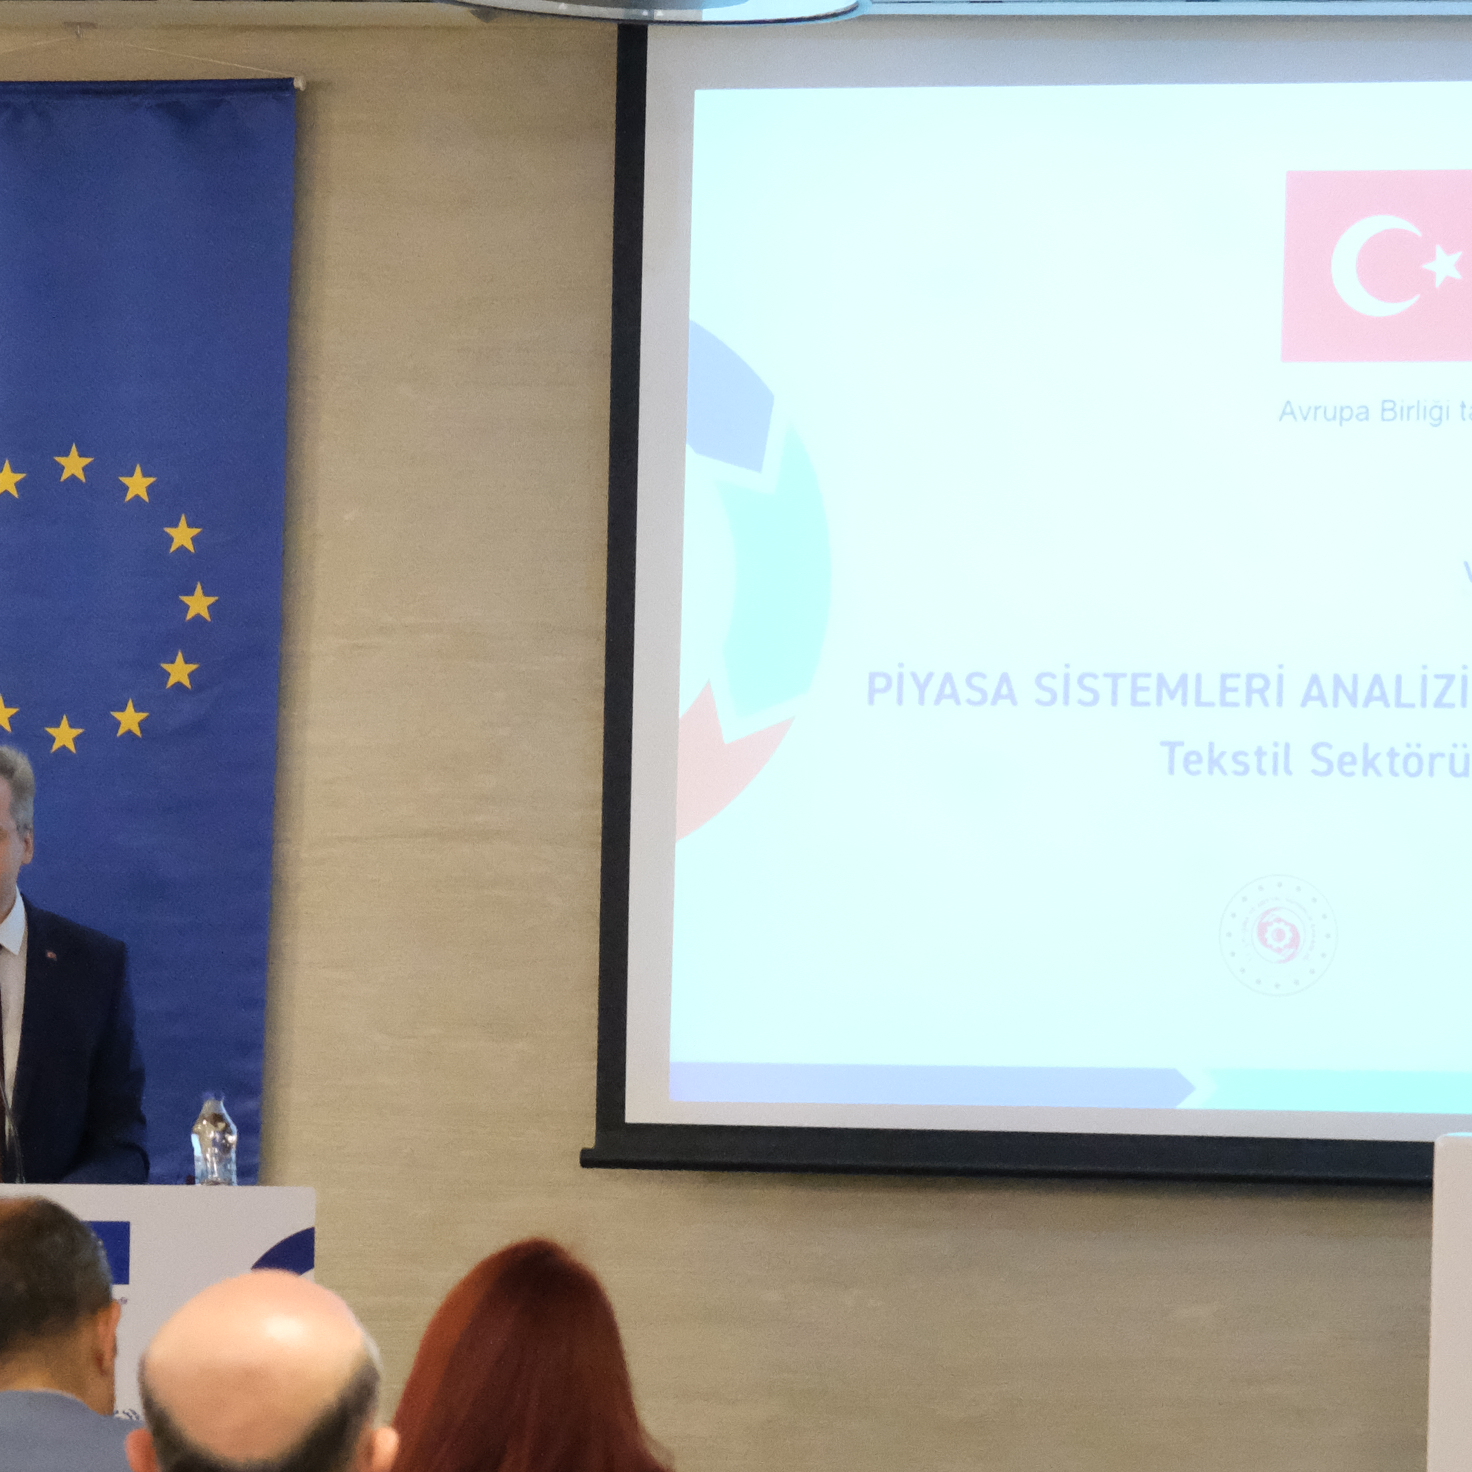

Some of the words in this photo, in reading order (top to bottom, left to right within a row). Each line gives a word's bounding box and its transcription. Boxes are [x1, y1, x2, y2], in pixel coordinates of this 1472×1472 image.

[1278, 399, 1370, 427] Avrupa
[1380, 398, 1450, 428] Birliği
[866, 662, 1019, 707] PİYASA
[1033, 663, 1285, 708] SİSTEMLERİ
[1159, 740, 1294, 777] Tekstil
